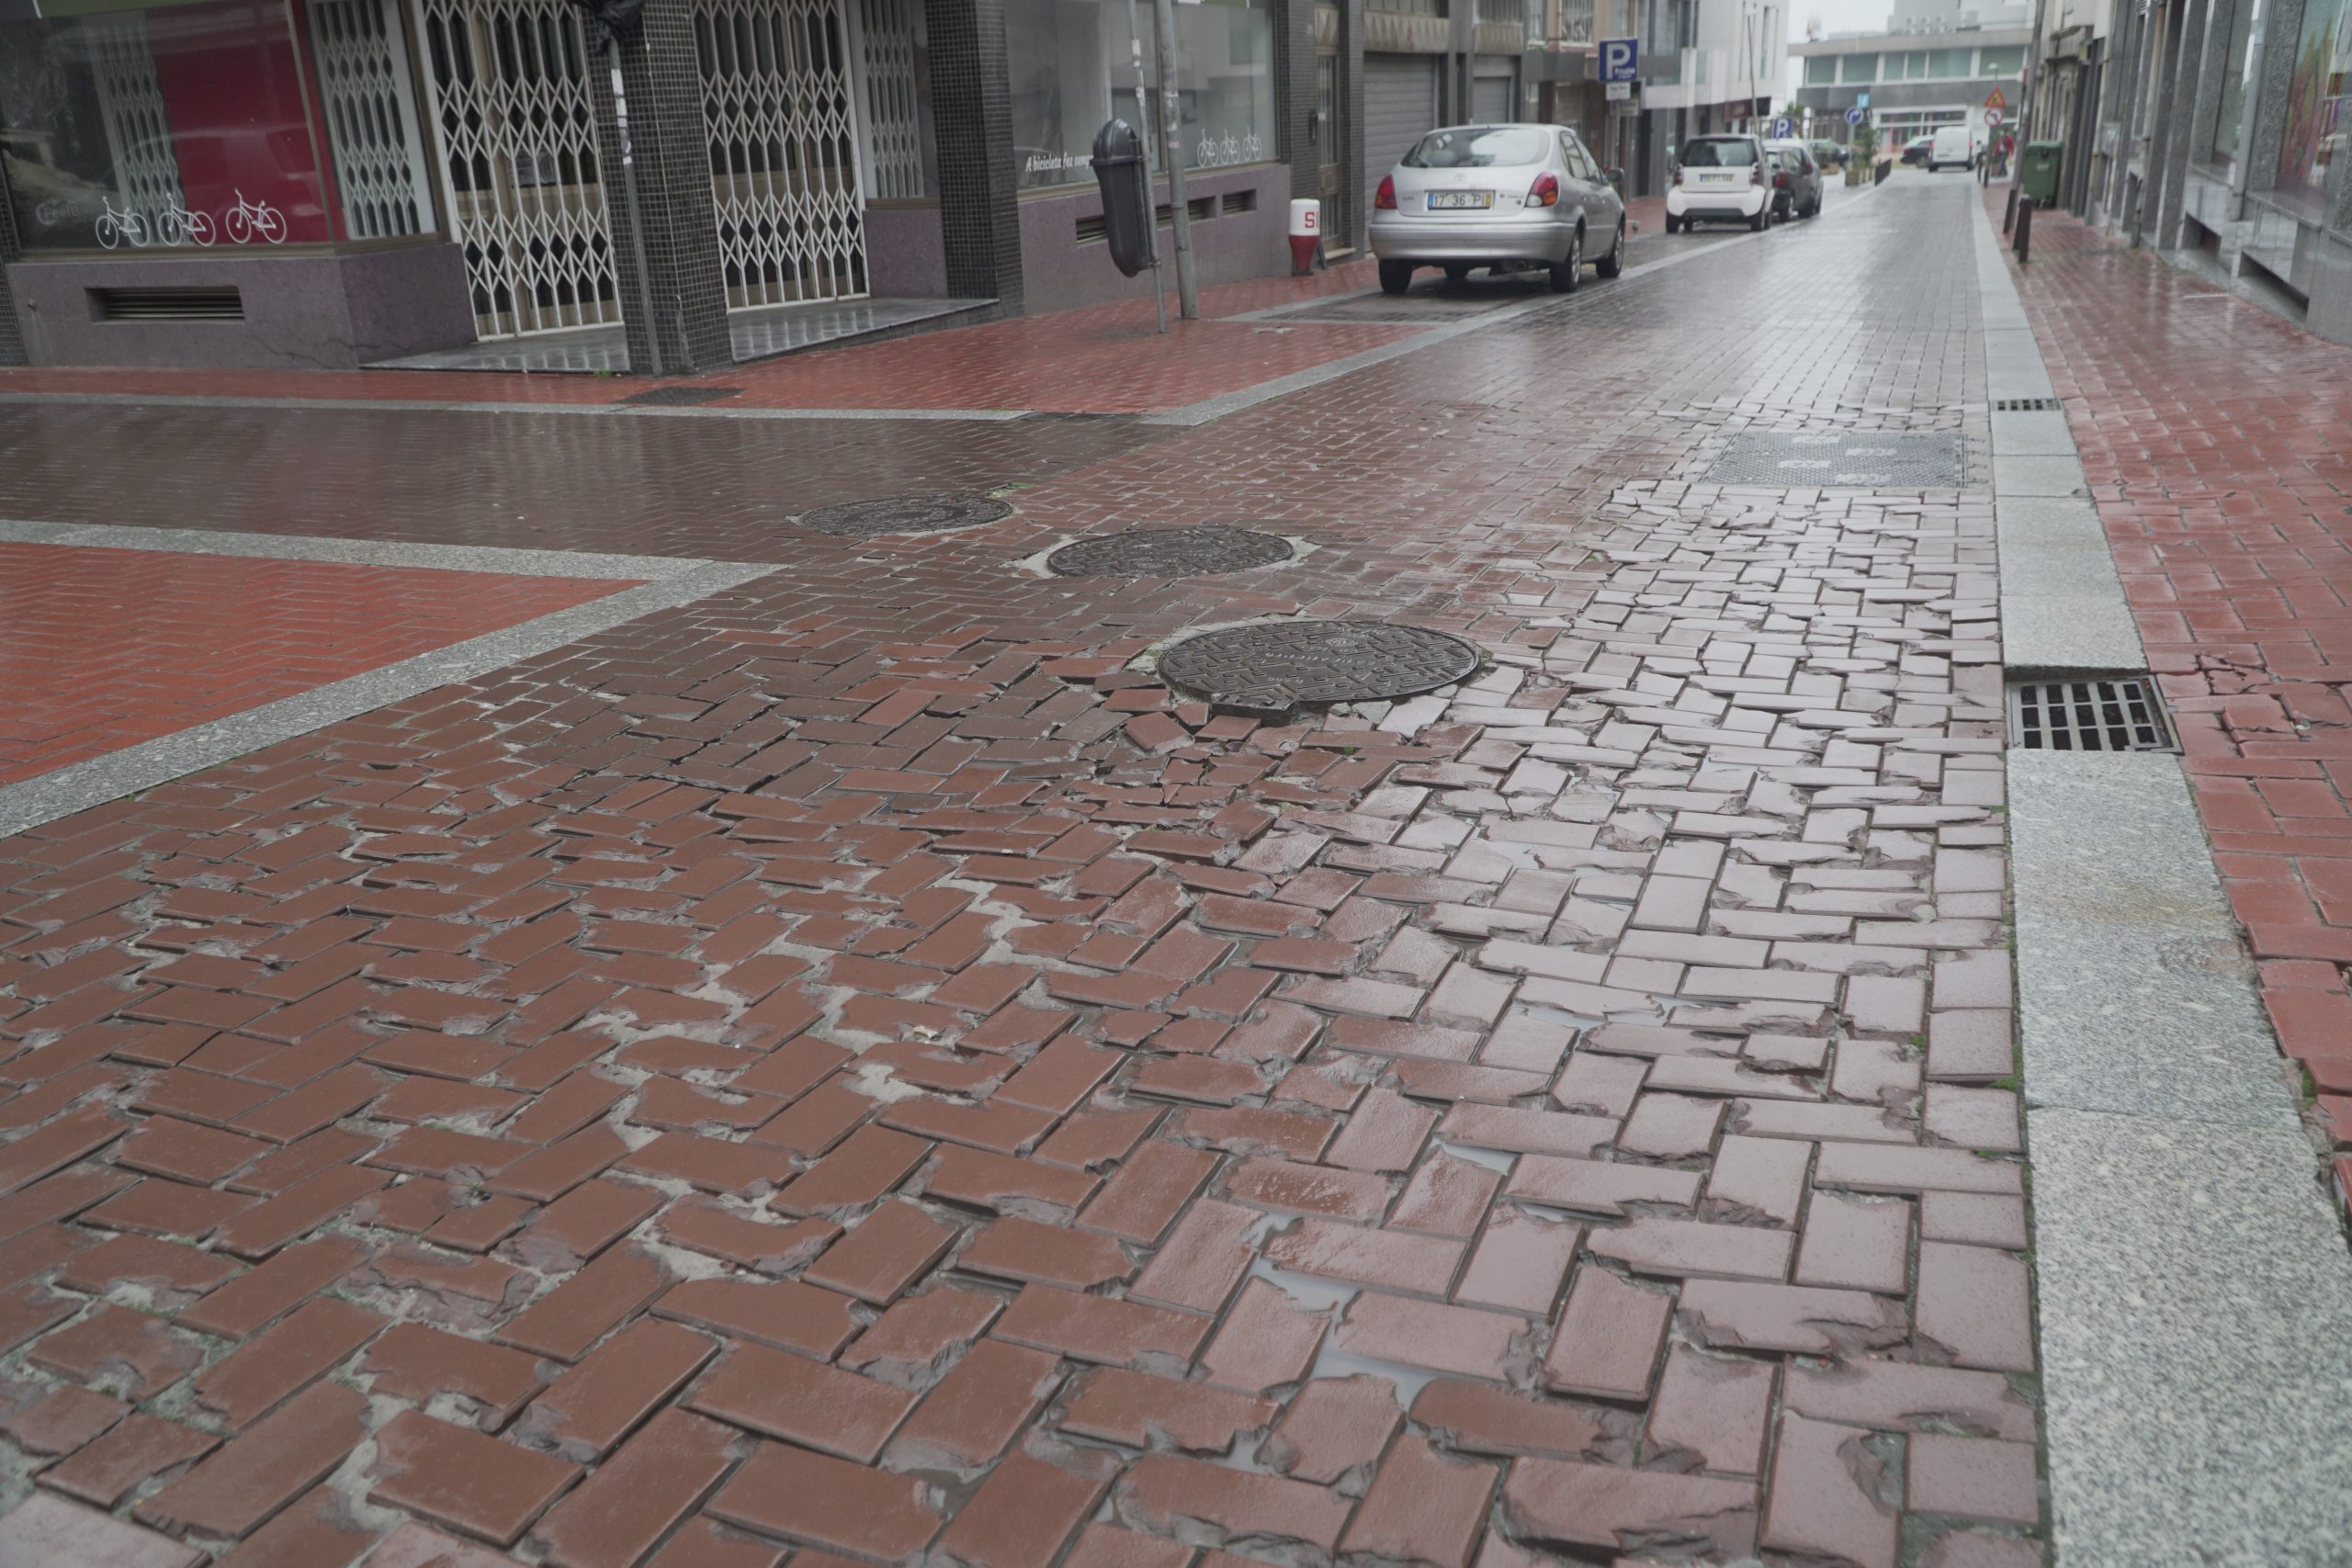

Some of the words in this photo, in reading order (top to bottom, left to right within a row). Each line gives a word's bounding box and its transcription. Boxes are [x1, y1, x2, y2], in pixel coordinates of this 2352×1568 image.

[1607, 43, 1631, 80] P
[1778, 118, 1789, 136] P
[1025, 156, 1032, 172] A
[1033, 153, 1062, 172] bicicleta
[1062, 152, 1073, 170] fez
